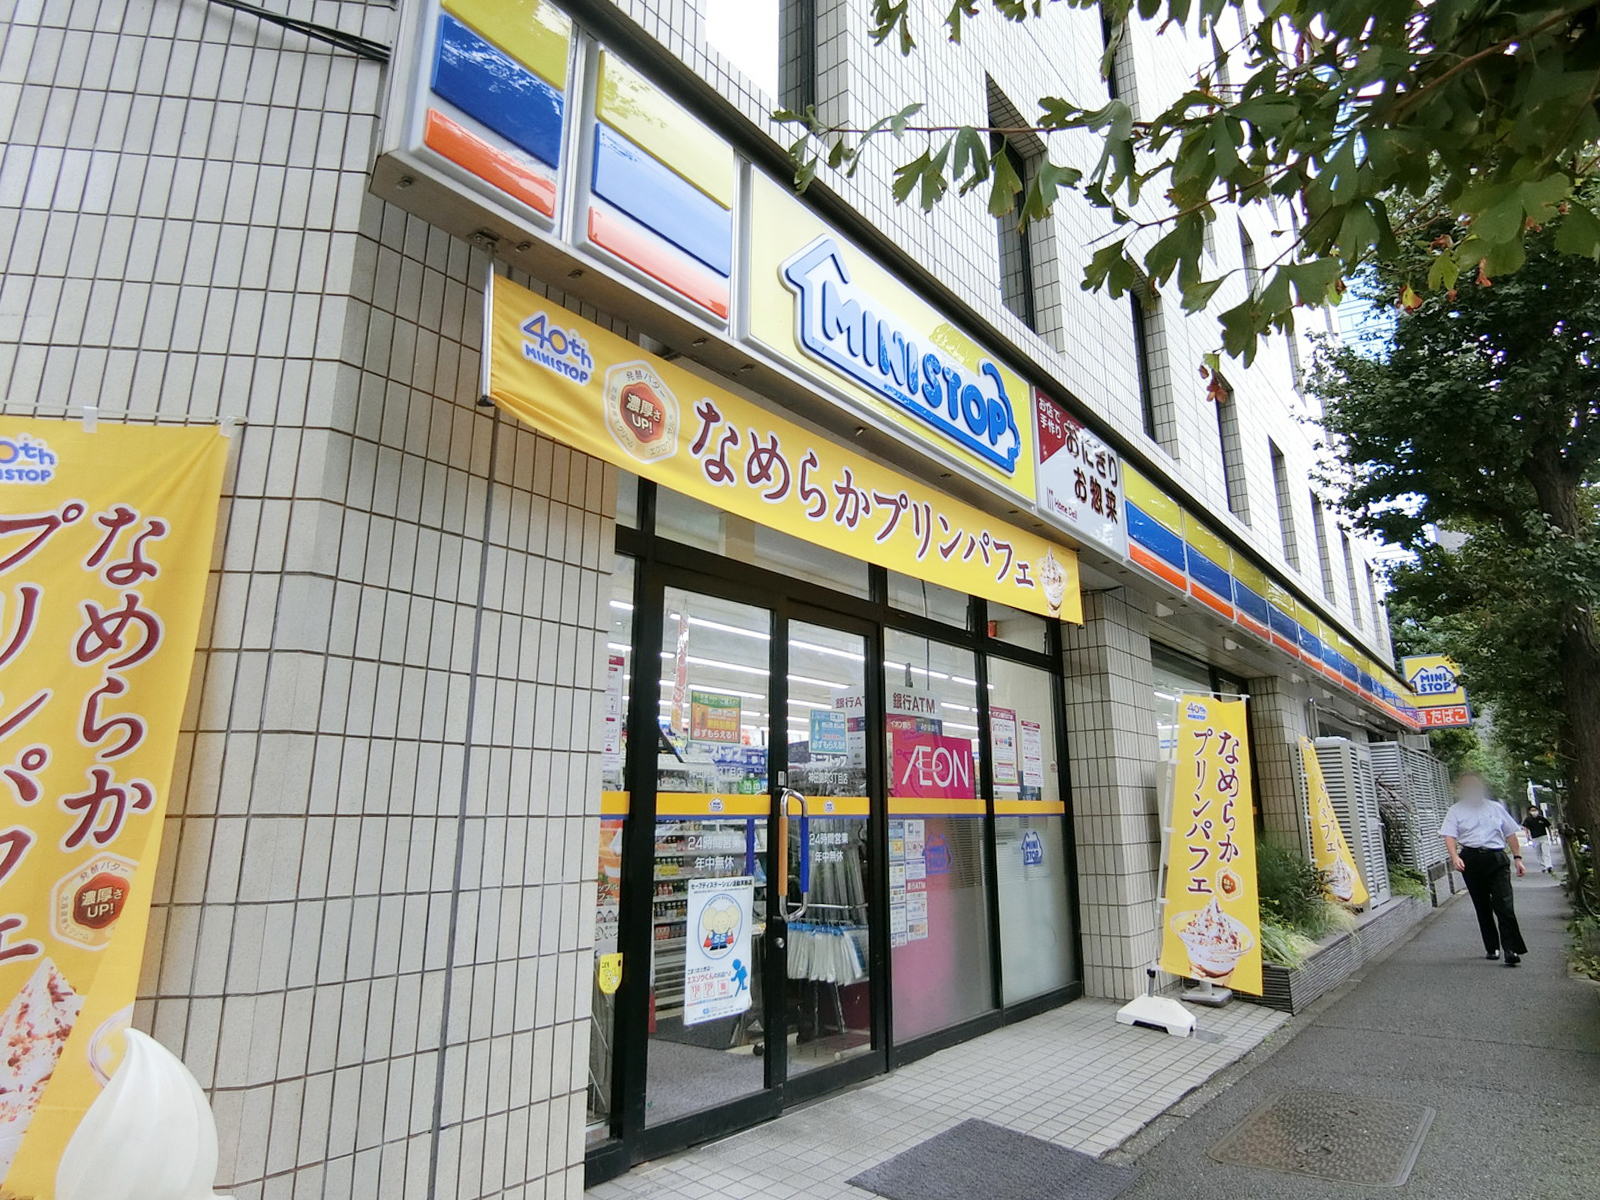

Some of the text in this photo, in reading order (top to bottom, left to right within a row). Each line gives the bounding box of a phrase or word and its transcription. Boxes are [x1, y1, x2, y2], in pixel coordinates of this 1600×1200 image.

[523, 314, 592, 369] 40th
[525, 343, 589, 383] MINISTOP
[822, 280, 1007, 446] MINISTOP
[626, 393, 661, 422] 濃厚さ
[1039, 397, 1061, 424] お店で
[631, 413, 653, 434] UP!
[1040, 413, 1062, 438] 手作り
[1065, 424, 1118, 488] おにぎり
[692, 401, 1035, 588] なめらかプリンパフェ
[1073, 466, 1118, 524] お惣菜
[64, 507, 166, 849] なめらか
[1420, 672, 1447, 683] MINI
[1420, 682, 1451, 693] STOP
[892, 692, 936, 714] 銀行ATM
[810, 754, 847, 767] ミニストップ
[1217, 731, 1240, 863] なめらか
[1186, 728, 1213, 894] プリンパフェ
[688, 836, 743, 850] 24時間営業
[809, 832, 849, 845] 24時間営業
[1025, 840, 1039, 850] MINI
[694, 855, 735, 870] 年中無休
[814, 850, 844, 863] 年中無休
[1025, 850, 1040, 862] STOP
[81, 886, 124, 907] 濃厚さ
[87, 902, 114, 918] UP!
[713, 934, 726, 943] SS
